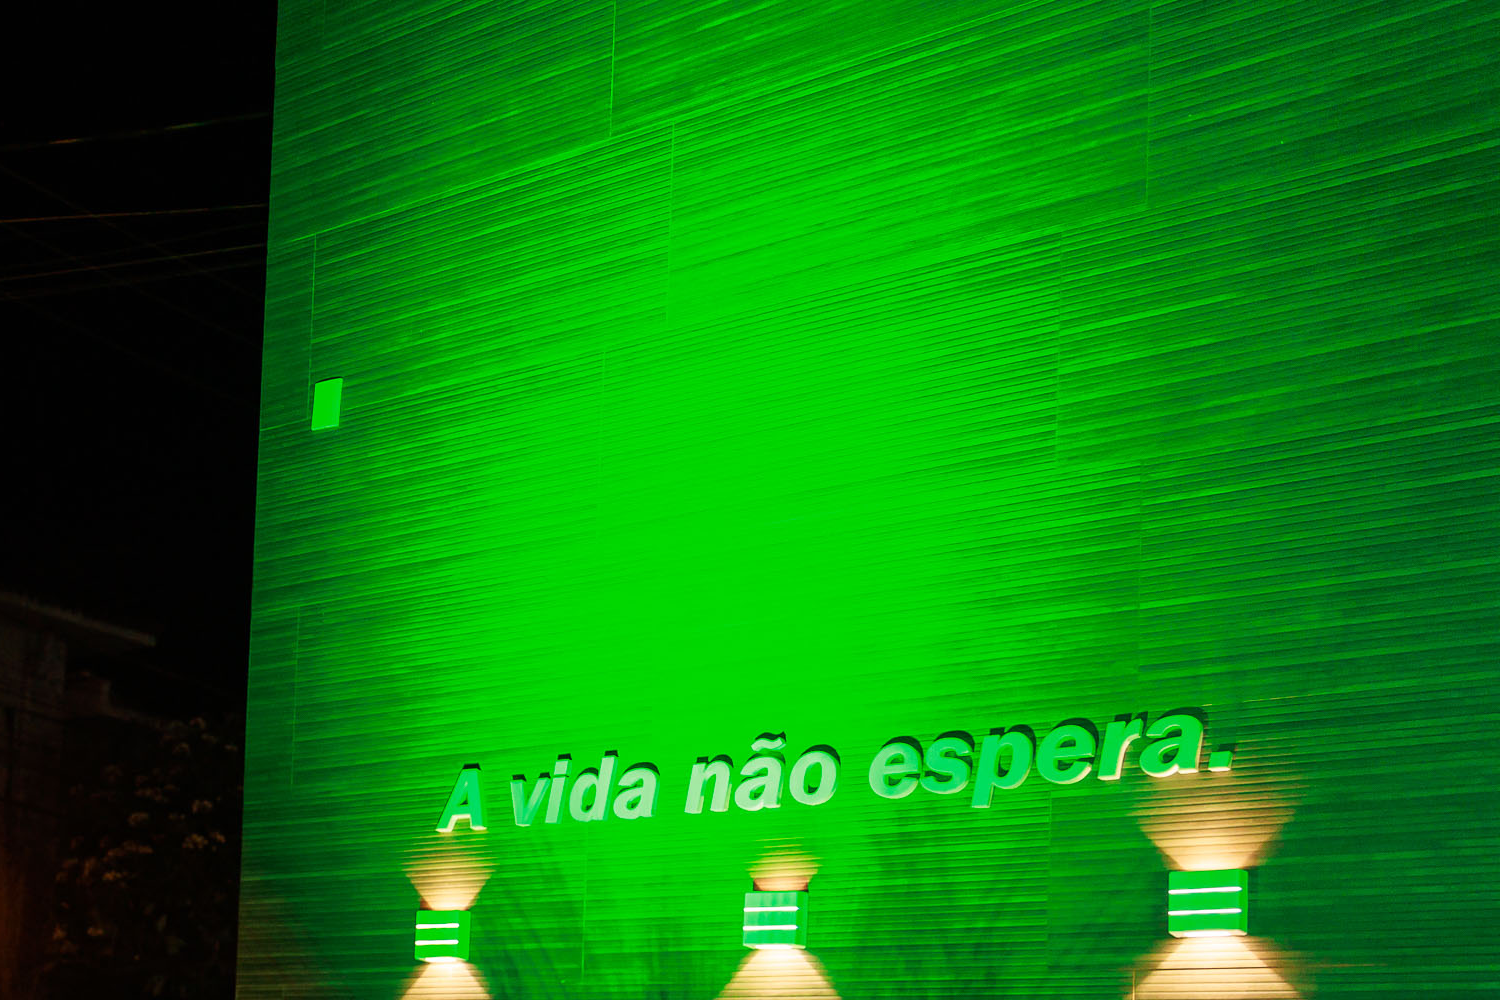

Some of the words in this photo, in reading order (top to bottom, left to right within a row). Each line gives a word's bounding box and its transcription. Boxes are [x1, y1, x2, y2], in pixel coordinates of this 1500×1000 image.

[436, 766, 488, 833] A
[510, 752, 657, 828] vida
[684, 733, 839, 815] não
[868, 712, 1234, 809] espera.
